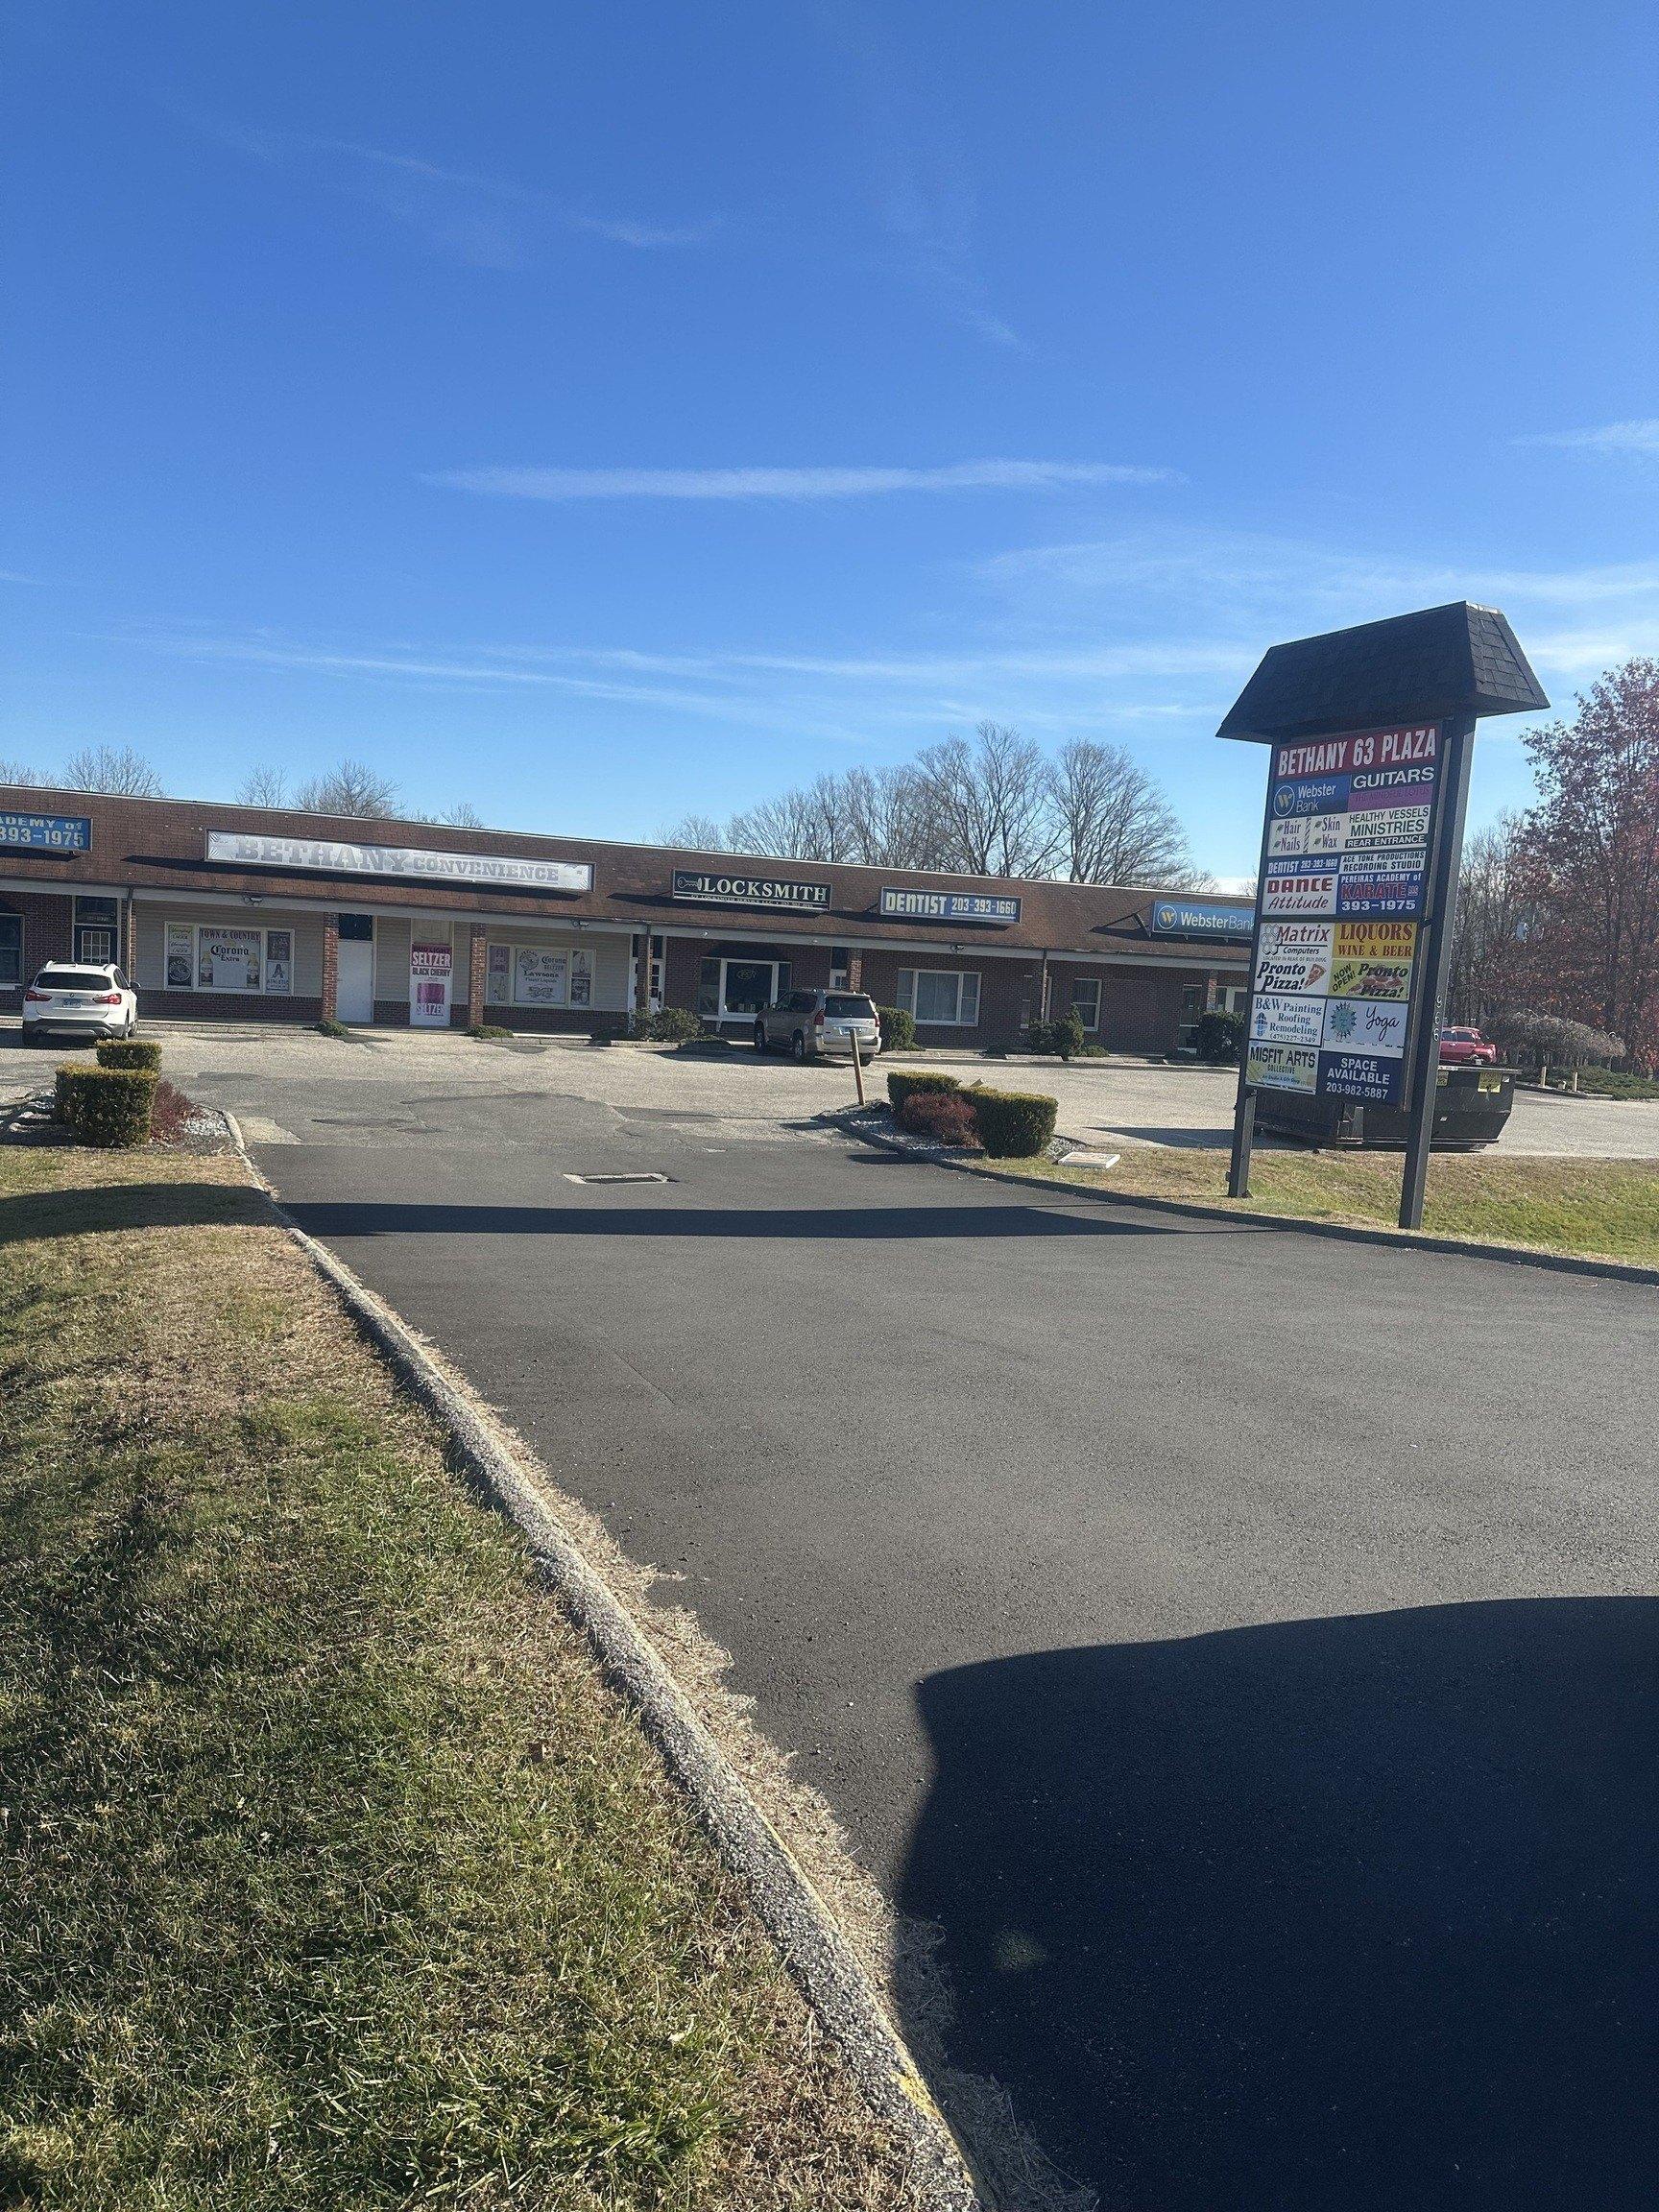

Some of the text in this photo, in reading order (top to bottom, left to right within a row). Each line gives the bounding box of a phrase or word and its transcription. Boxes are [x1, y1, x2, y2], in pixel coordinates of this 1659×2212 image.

[1278, 728, 1436, 777] BETHANY 63 PLAZA
[1353, 767, 1435, 789] GUITARS
[1298, 783, 1336, 799] Webster
[1296, 799, 1319, 813] Bank
[1349, 806, 1430, 824] HEALTHY VESSELS
[64, 821, 84, 830] of
[1284, 816, 1341, 834] Hair Skin
[1350, 819, 1425, 837] MINISTRIES
[1281, 833, 1338, 852] Nails Wax
[1347, 834, 1425, 848] REAR ENTRANCE
[236, 836, 559, 881] BETHANY CONVENIENCE
[1377, 852, 1425, 861] PRODUCTIONS
[1267, 860, 1299, 875] DENTIST
[1343, 860, 1421, 872] RECORDING STUDIO
[1267, 878, 1334, 893] DANCE
[1341, 872, 1422, 883] PEREIRAS ACADEMY of
[703, 877, 828, 902] LOCKSMITH
[1340, 882, 1407, 900] KARATE
[885, 892, 1017, 915] DENTIST 203-393-1660
[1268, 895, 1329, 909] Attitude
[1341, 900, 1416, 911] 393-1975
[200, 928, 218, 940] TOWN
[220, 930, 228, 940] &
[229, 930, 261, 941] COUNTRY
[1276, 925, 1331, 942] Matrix
[1339, 924, 1413, 943] LIQUORS
[210, 945, 250, 956] Corona
[1283, 947, 1320, 955] Computers
[1337, 945, 1412, 957] WINE & BEER
[412, 951, 451, 968] SELTZER
[412, 967, 429, 976] BLACK
[1257, 961, 1307, 978] Pronto
[1333, 963, 1352, 981] NOW
[1358, 963, 1409, 978] Pronto
[1261, 974, 1305, 993] Pizza!
[1332, 970, 1357, 993] OPEN!
[1255, 997, 1322, 1016] B&W Painting
[1278, 1012, 1310, 1025] Roofing
[1365, 1005, 1400, 1042] Yoga
[1269, 1022, 1318, 1037] Remodeling
[1250, 1046, 1316, 1069] MISFIT ARTS
[1340, 1057, 1378, 1072] SPACE
[1267, 1064, 1296, 1074] COLLECTIVE
[1327, 1067, 1390, 1085] AVAILABLE
[1326, 1082, 1388, 1100] 203-982-5887
